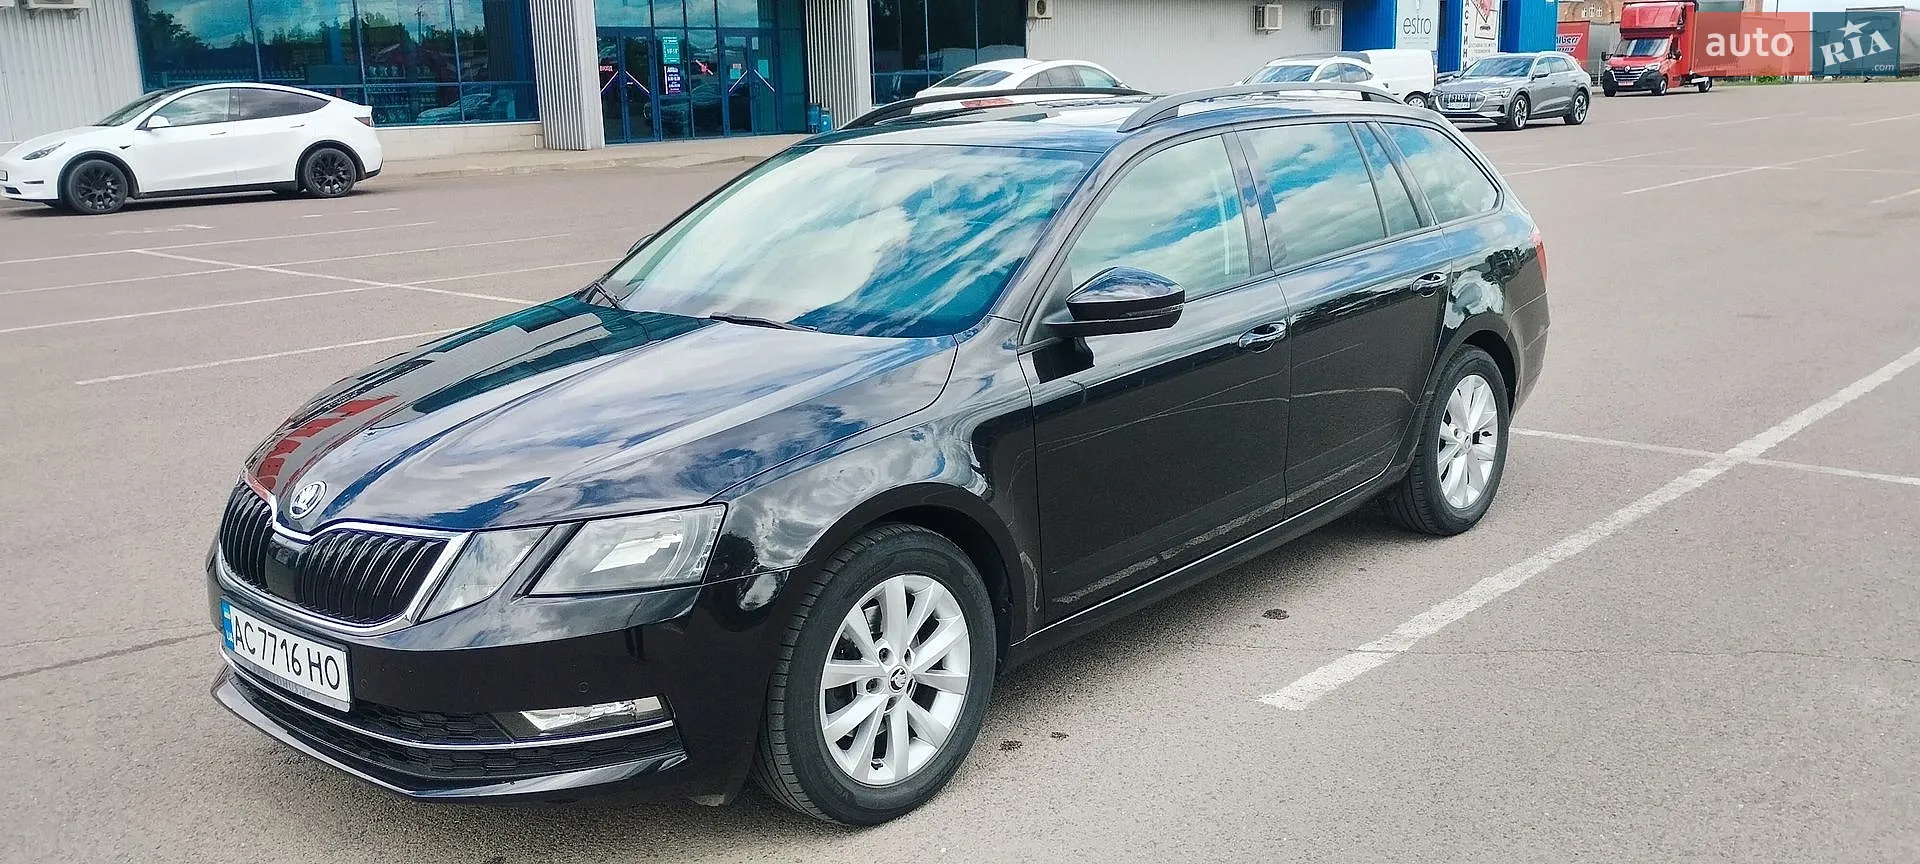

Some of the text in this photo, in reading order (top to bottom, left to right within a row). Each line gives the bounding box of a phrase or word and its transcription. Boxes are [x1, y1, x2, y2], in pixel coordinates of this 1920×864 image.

[1403, 15, 1432, 35] estro
[235, 616, 341, 691] AC 7716 HO
